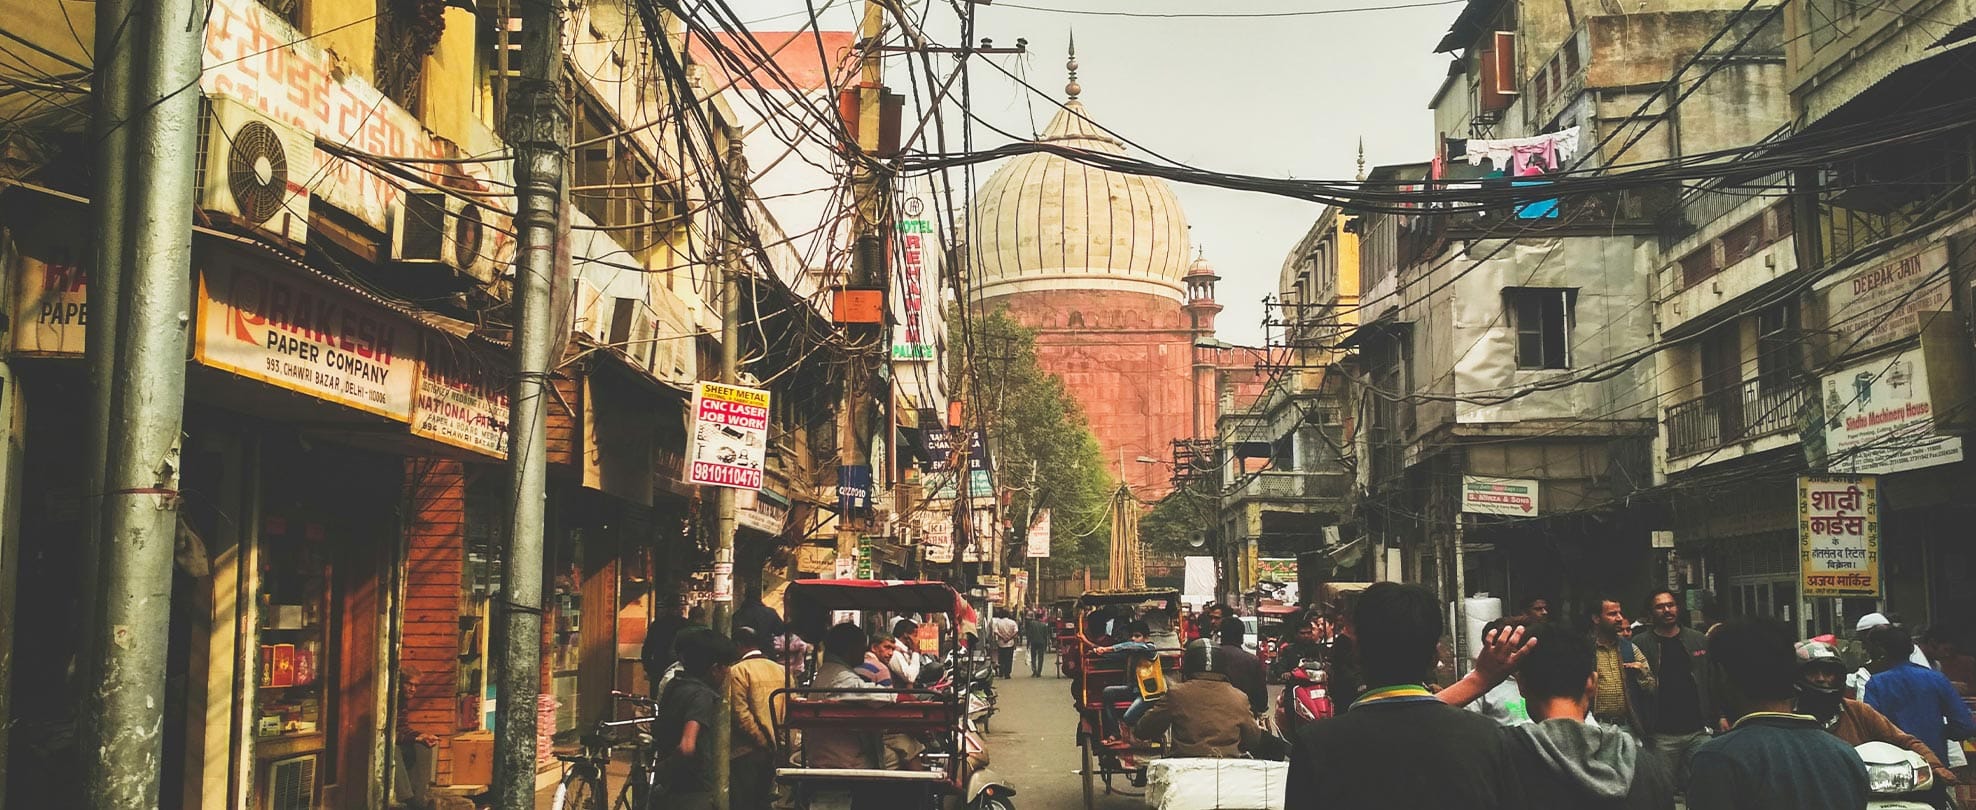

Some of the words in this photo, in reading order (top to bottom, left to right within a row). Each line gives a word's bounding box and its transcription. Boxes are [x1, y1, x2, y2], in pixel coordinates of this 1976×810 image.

[43, 262, 87, 293] RA
[1853, 265, 1894, 295] DEEPAK
[1897, 255, 1921, 280] JAIN
[39, 302, 87, 325] PAPE
[269, 282, 395, 365] RAKESH
[267, 330, 319, 364] PAPER
[327, 350, 389, 386] COMPANY
[284, 360, 313, 382] CHAWRI
[705, 384, 733, 396] SHEET
[736, 390, 765, 402] METAL
[419, 394, 471, 424] NATIONAL
[700, 411, 725, 423] JOB
[728, 415, 765, 429] WORK
[702, 399, 728, 411] CNC
[730, 403, 765, 418] LASER
[1845, 416, 1868, 431] Sindhu
[1869, 406, 1905, 426] Machinery
[1906, 401, 1930, 417] House
[695, 463, 760, 487] 9810110476
[1811, 486, 1864, 511] शादी
[1807, 575, 1836, 587] अजय
